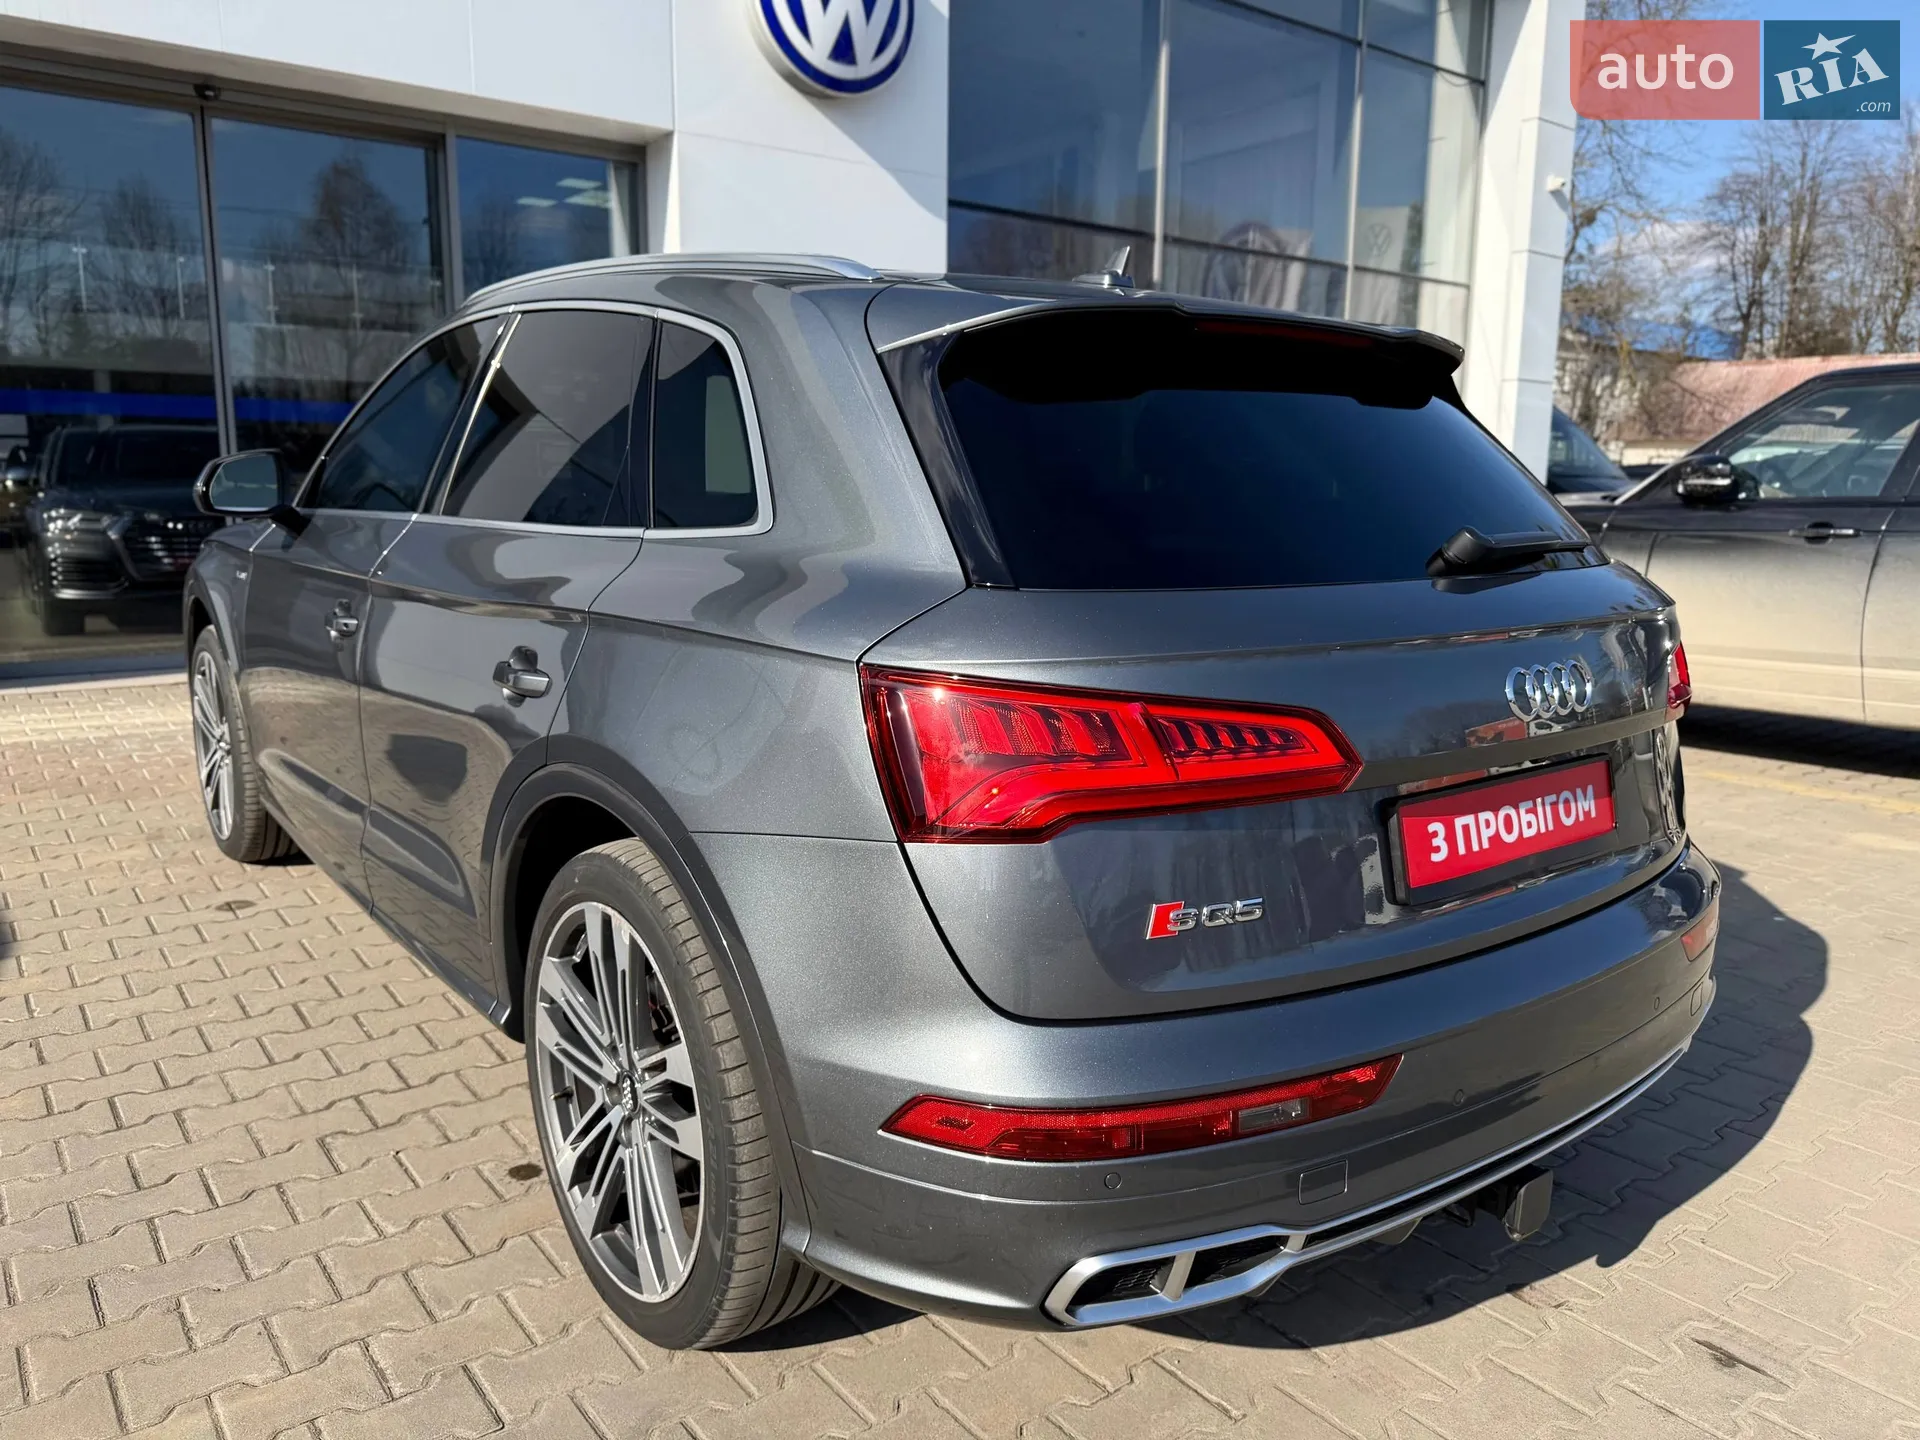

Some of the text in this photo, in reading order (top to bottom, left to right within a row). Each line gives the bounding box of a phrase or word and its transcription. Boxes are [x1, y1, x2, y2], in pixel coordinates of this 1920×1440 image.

[1426, 784, 1597, 863] З ПРОБІГОМ
[1166, 897, 1263, 931] SQ5
